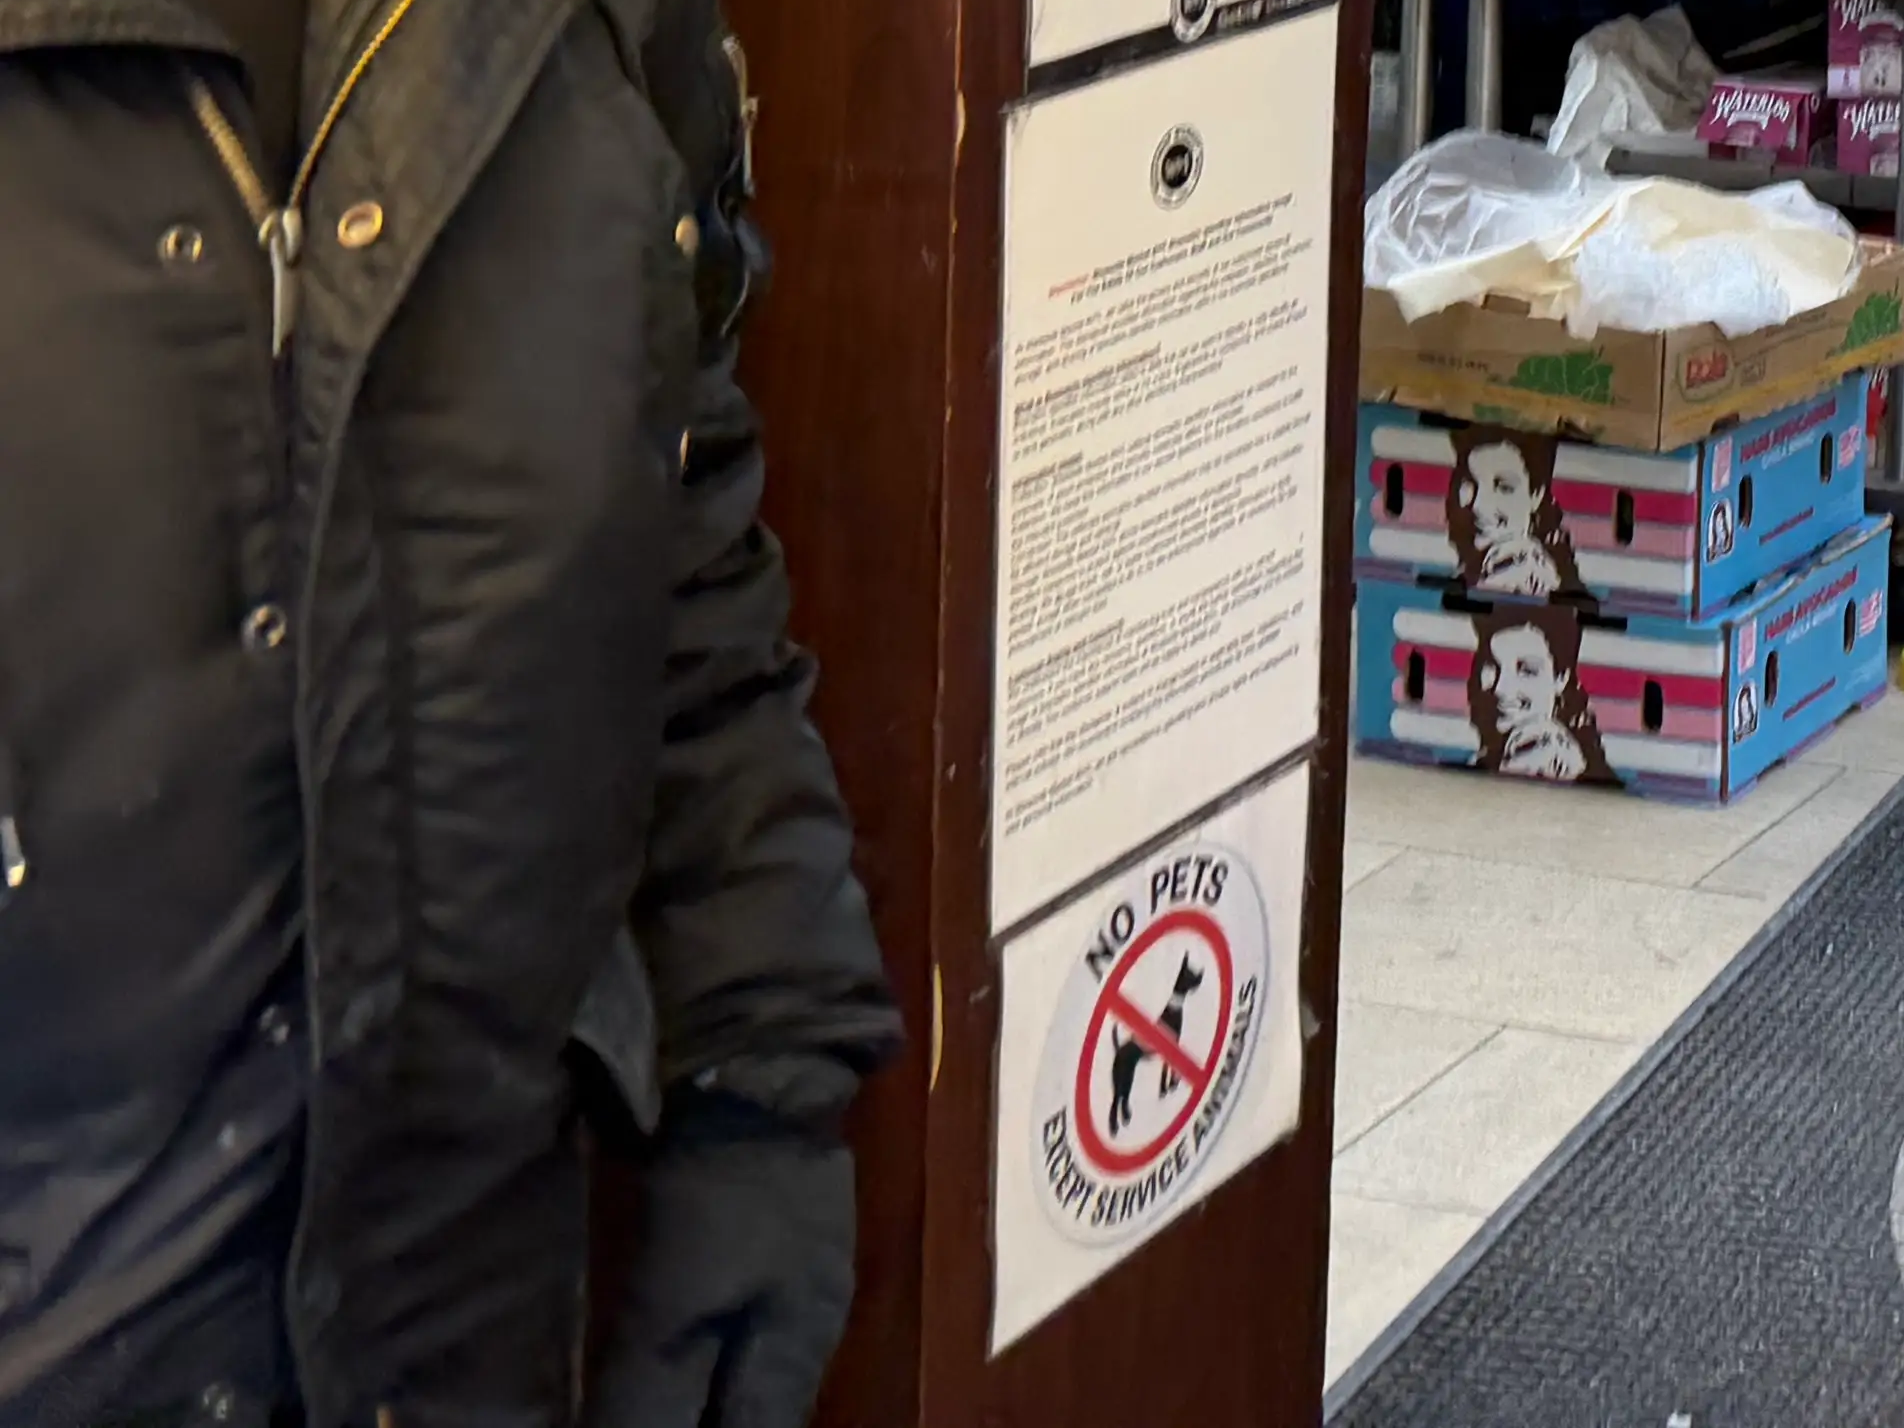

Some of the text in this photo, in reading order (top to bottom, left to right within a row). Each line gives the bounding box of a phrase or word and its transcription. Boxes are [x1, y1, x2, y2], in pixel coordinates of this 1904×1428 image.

[1709, 89, 1792, 126] WATERLOO
[1085, 852, 1228, 983] NO PETS
[1043, 975, 1257, 1226] EXCEPT SERVICE ANIMALS
